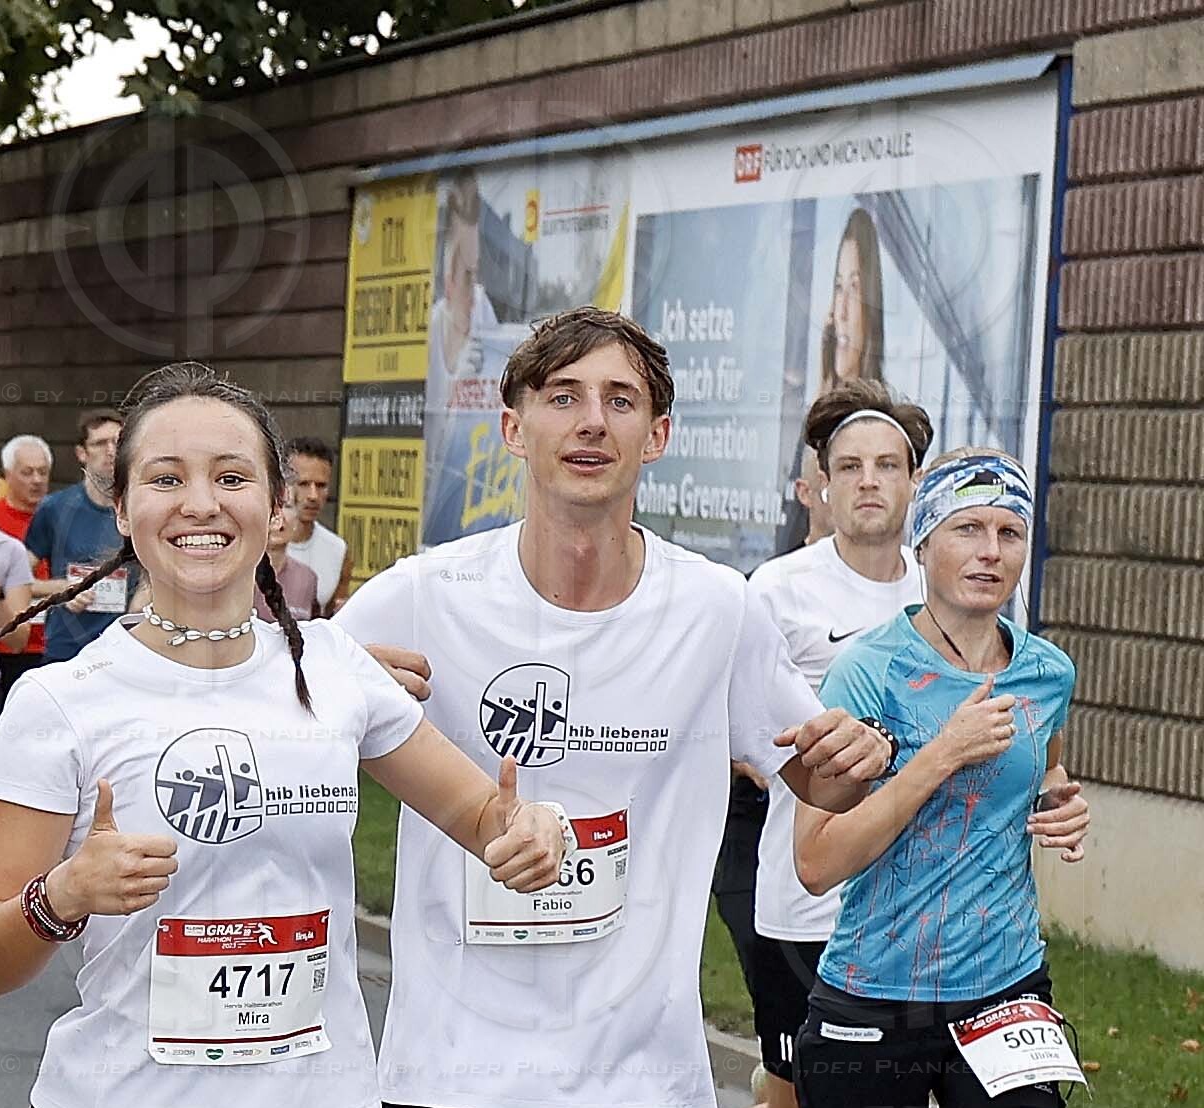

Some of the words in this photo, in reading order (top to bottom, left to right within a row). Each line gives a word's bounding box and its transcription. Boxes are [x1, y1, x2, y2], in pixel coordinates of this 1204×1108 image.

[689, 301, 734, 341] setze
[716, 357, 743, 400] für
[666, 414, 758, 460] formation
[637, 472, 676, 515] ohne
[680, 473, 750, 520] Grenzen
[569, 725, 594, 738] hib
[600, 726, 669, 739] liebenau
[266, 785, 293, 801] hib
[533, 899, 572, 912] Fabio
[206, 923, 244, 936] GRAZ
[197, 936, 232, 944] MARATHON
[208, 962, 295, 999] 4717
[238, 1012, 270, 1025] Mira
[984, 1008, 1012, 1023] GRAZ
[1003, 1027, 1063, 1049] 5073
